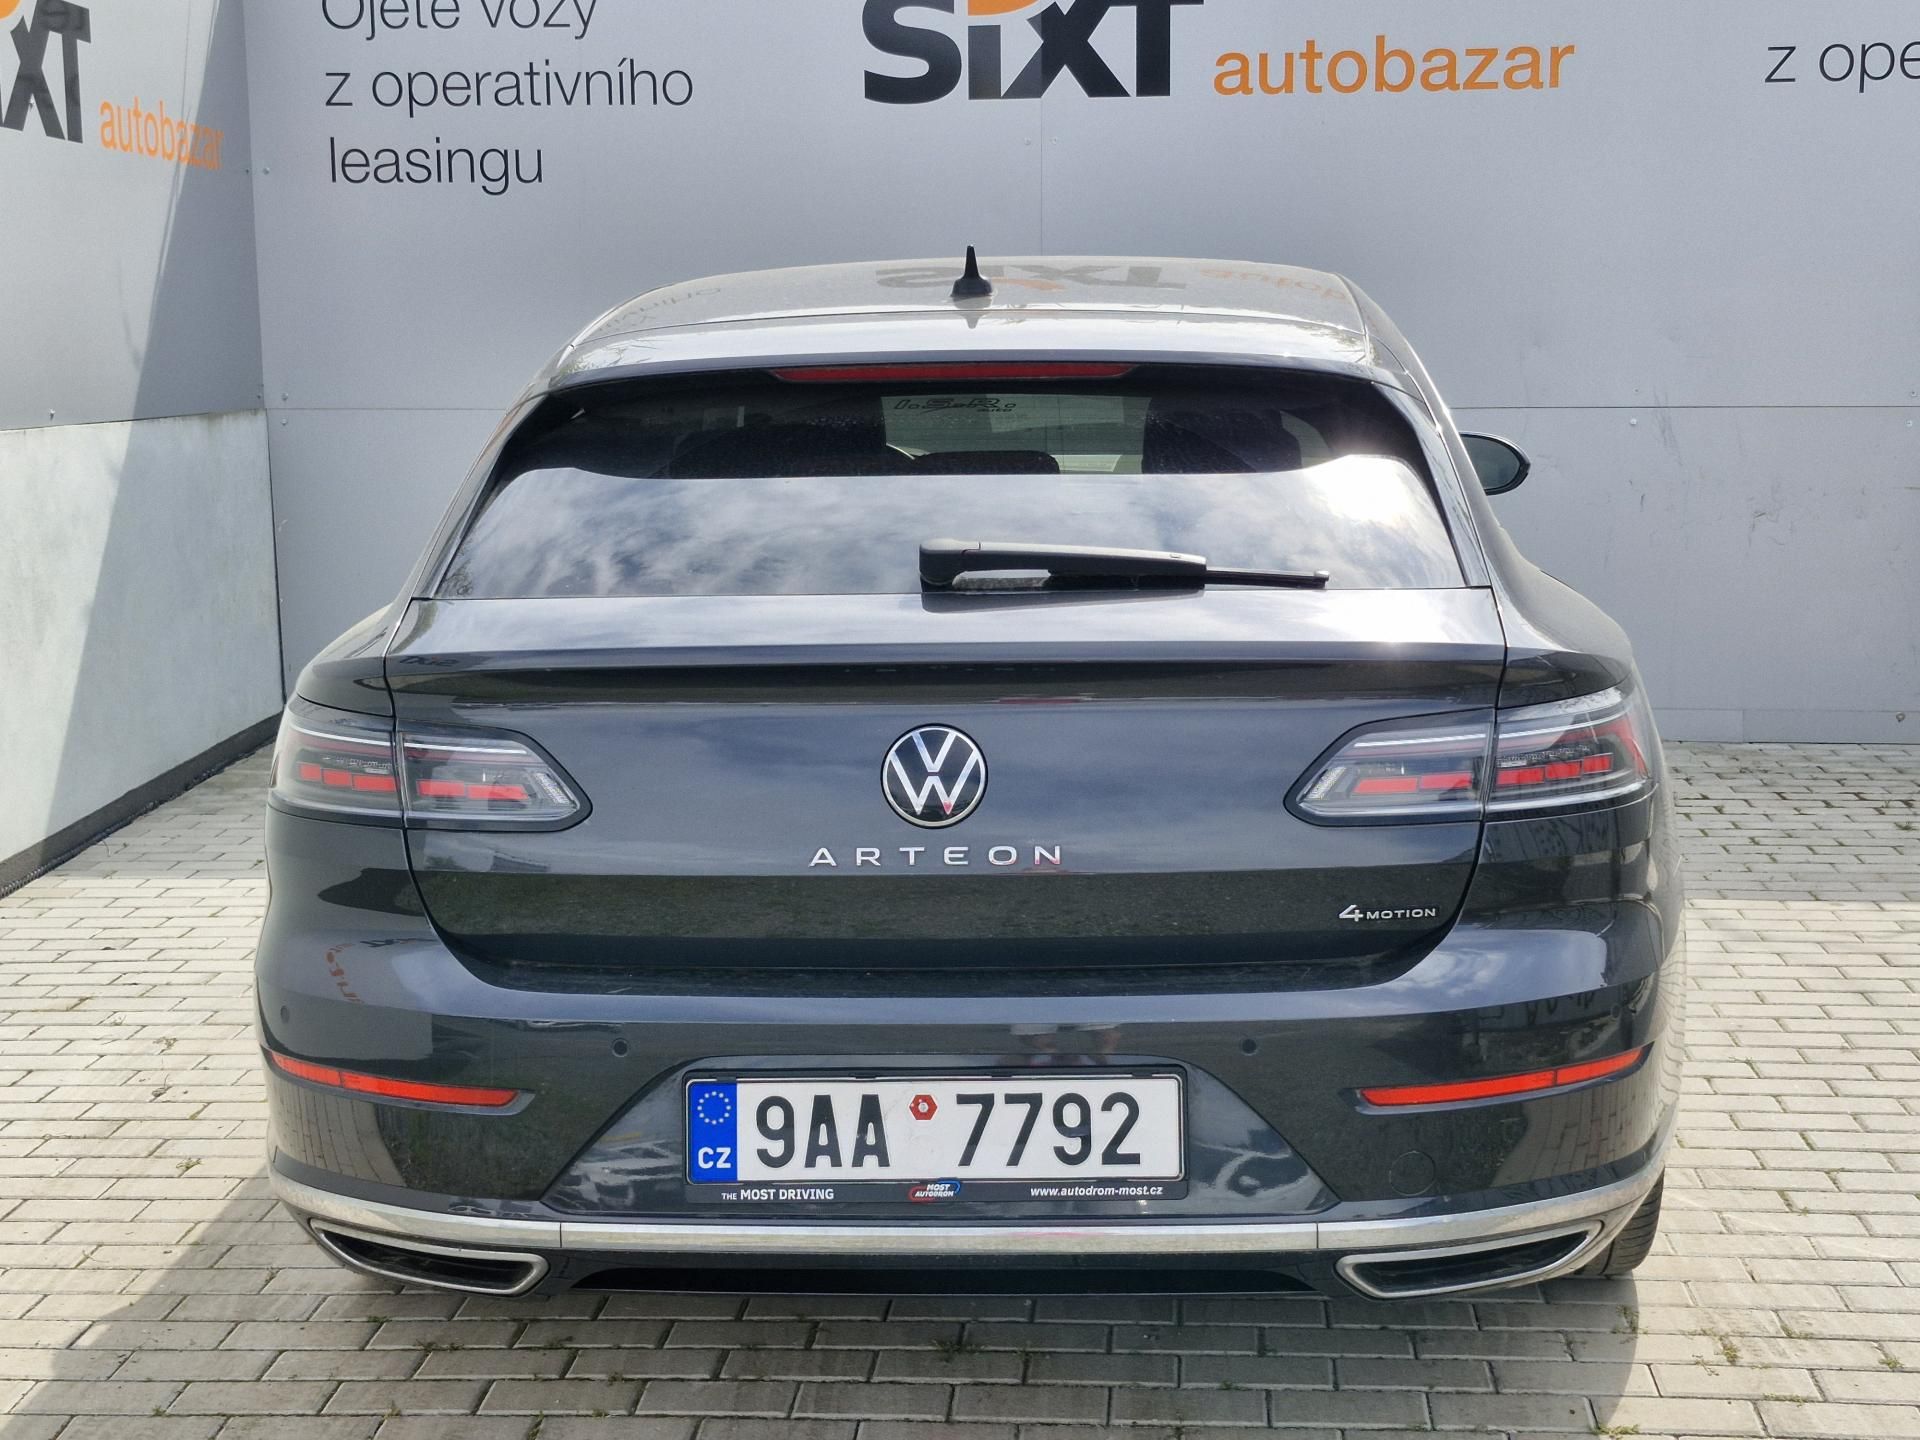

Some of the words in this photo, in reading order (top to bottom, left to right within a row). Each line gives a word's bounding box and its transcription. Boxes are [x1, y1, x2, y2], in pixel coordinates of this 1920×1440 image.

[480, 0, 597, 40] vozy
[1213, 35, 1576, 96] autobazar
[1764, 46, 1797, 83] z
[325, 72, 353, 107] z
[372, 57, 693, 118] operativního
[100, 95, 224, 171] autobazar
[329, 136, 543, 196] leasingu
[808, 845, 1061, 867] ARTEON
[755, 1094, 891, 1169] 9AA
[956, 1091, 1141, 1167] 7792
[697, 1147, 731, 1168] CZ
[721, 1192, 738, 1201] THE
[740, 1189, 775, 1200] MOST
[779, 1188, 835, 1200] DRIVING
[1030, 1185, 1163, 1197] www.autodrom-most.cz
